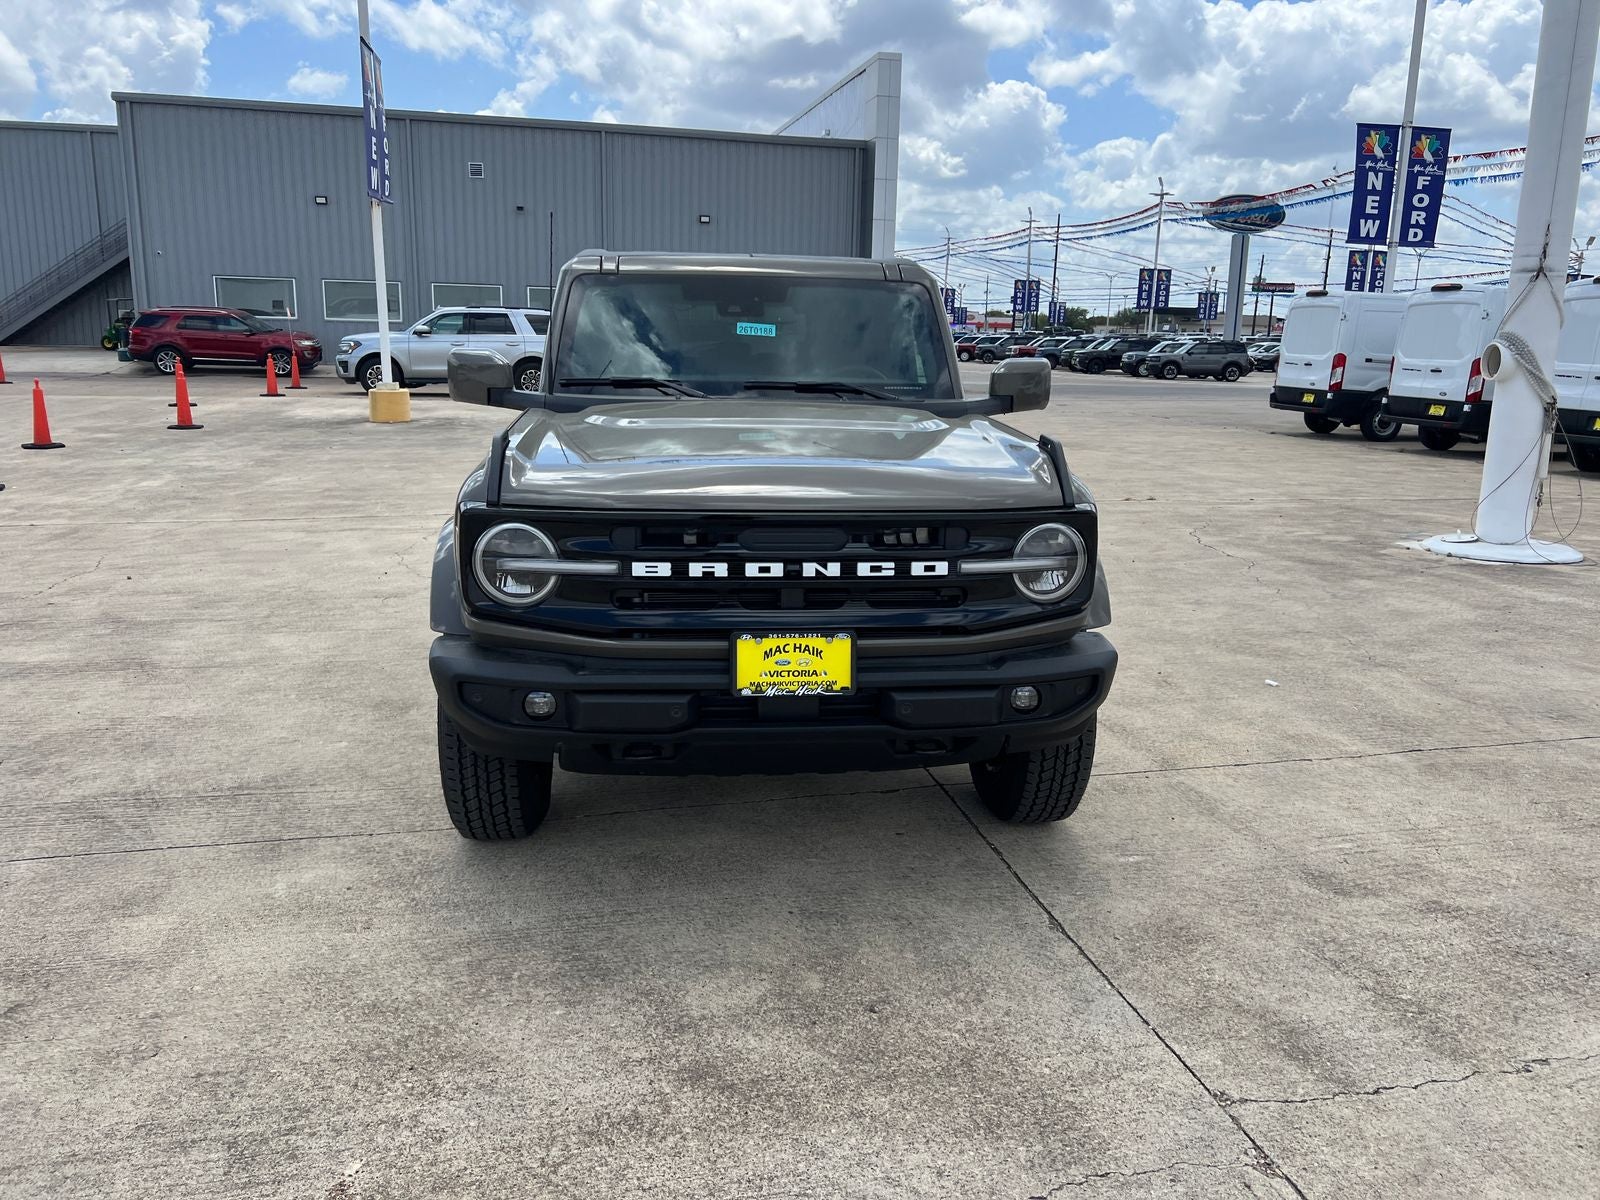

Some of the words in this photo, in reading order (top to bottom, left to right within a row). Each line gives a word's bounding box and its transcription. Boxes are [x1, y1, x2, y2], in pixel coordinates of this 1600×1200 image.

[1359, 171, 1383, 238] NEW
[1407, 176, 1431, 242] FORD
[1351, 271, 1361, 290] NE
[1374, 272, 1384, 293] FOR
[1140, 284, 1149, 306] NEW
[1158, 285, 1166, 307] FORD
[738, 325, 773, 335] 26T0188
[631, 561, 949, 577] BRONCO
[763, 643, 790, 661] MAC
[793, 643, 824, 660] HAIK
[768, 669, 819, 678] VICTORIA
[749, 680, 838, 688] MACHAIKVICTORIA.COM
[764, 685, 789, 696] Mac
[794, 684, 825, 696] Haik
